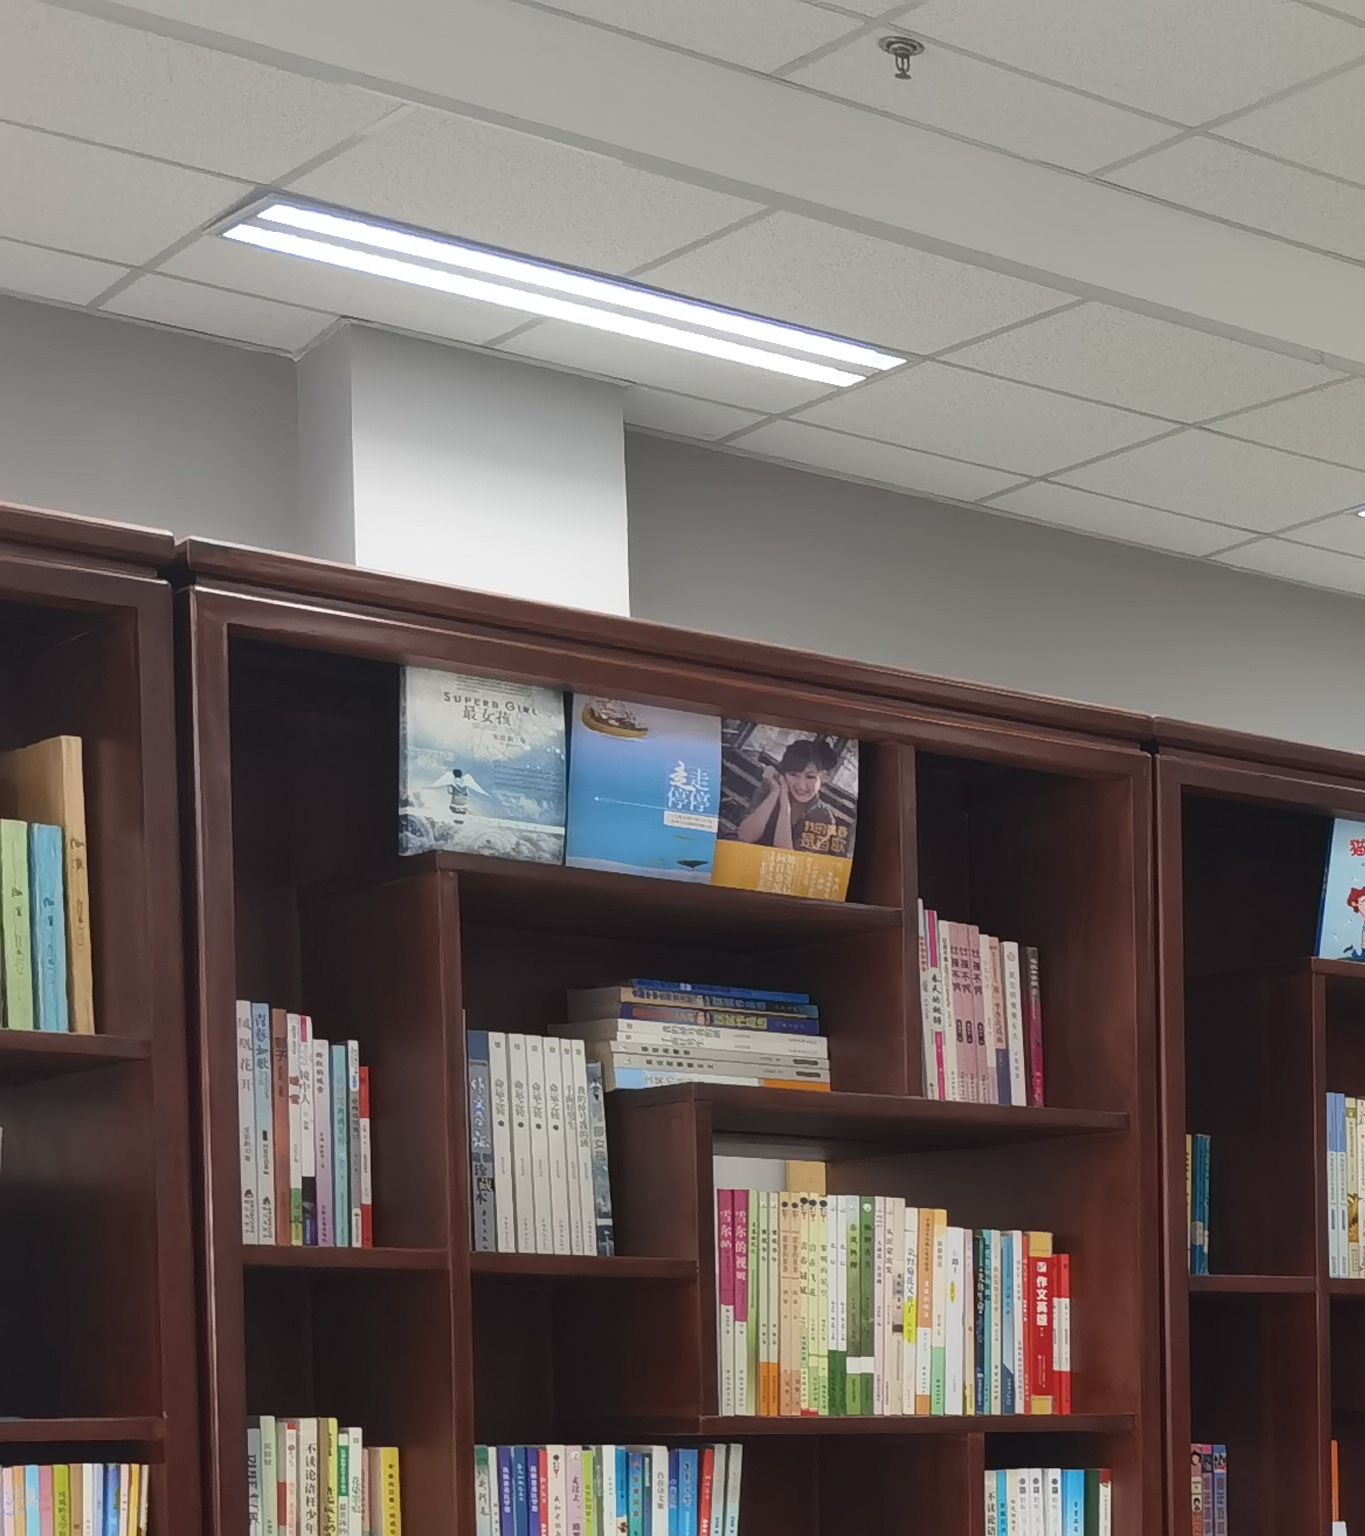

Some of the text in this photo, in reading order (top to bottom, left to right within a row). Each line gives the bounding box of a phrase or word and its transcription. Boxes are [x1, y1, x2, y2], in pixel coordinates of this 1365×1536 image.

[462, 704, 512, 727] 最女孩
[304, 1442, 318, 1535] 不读论语枉少年
